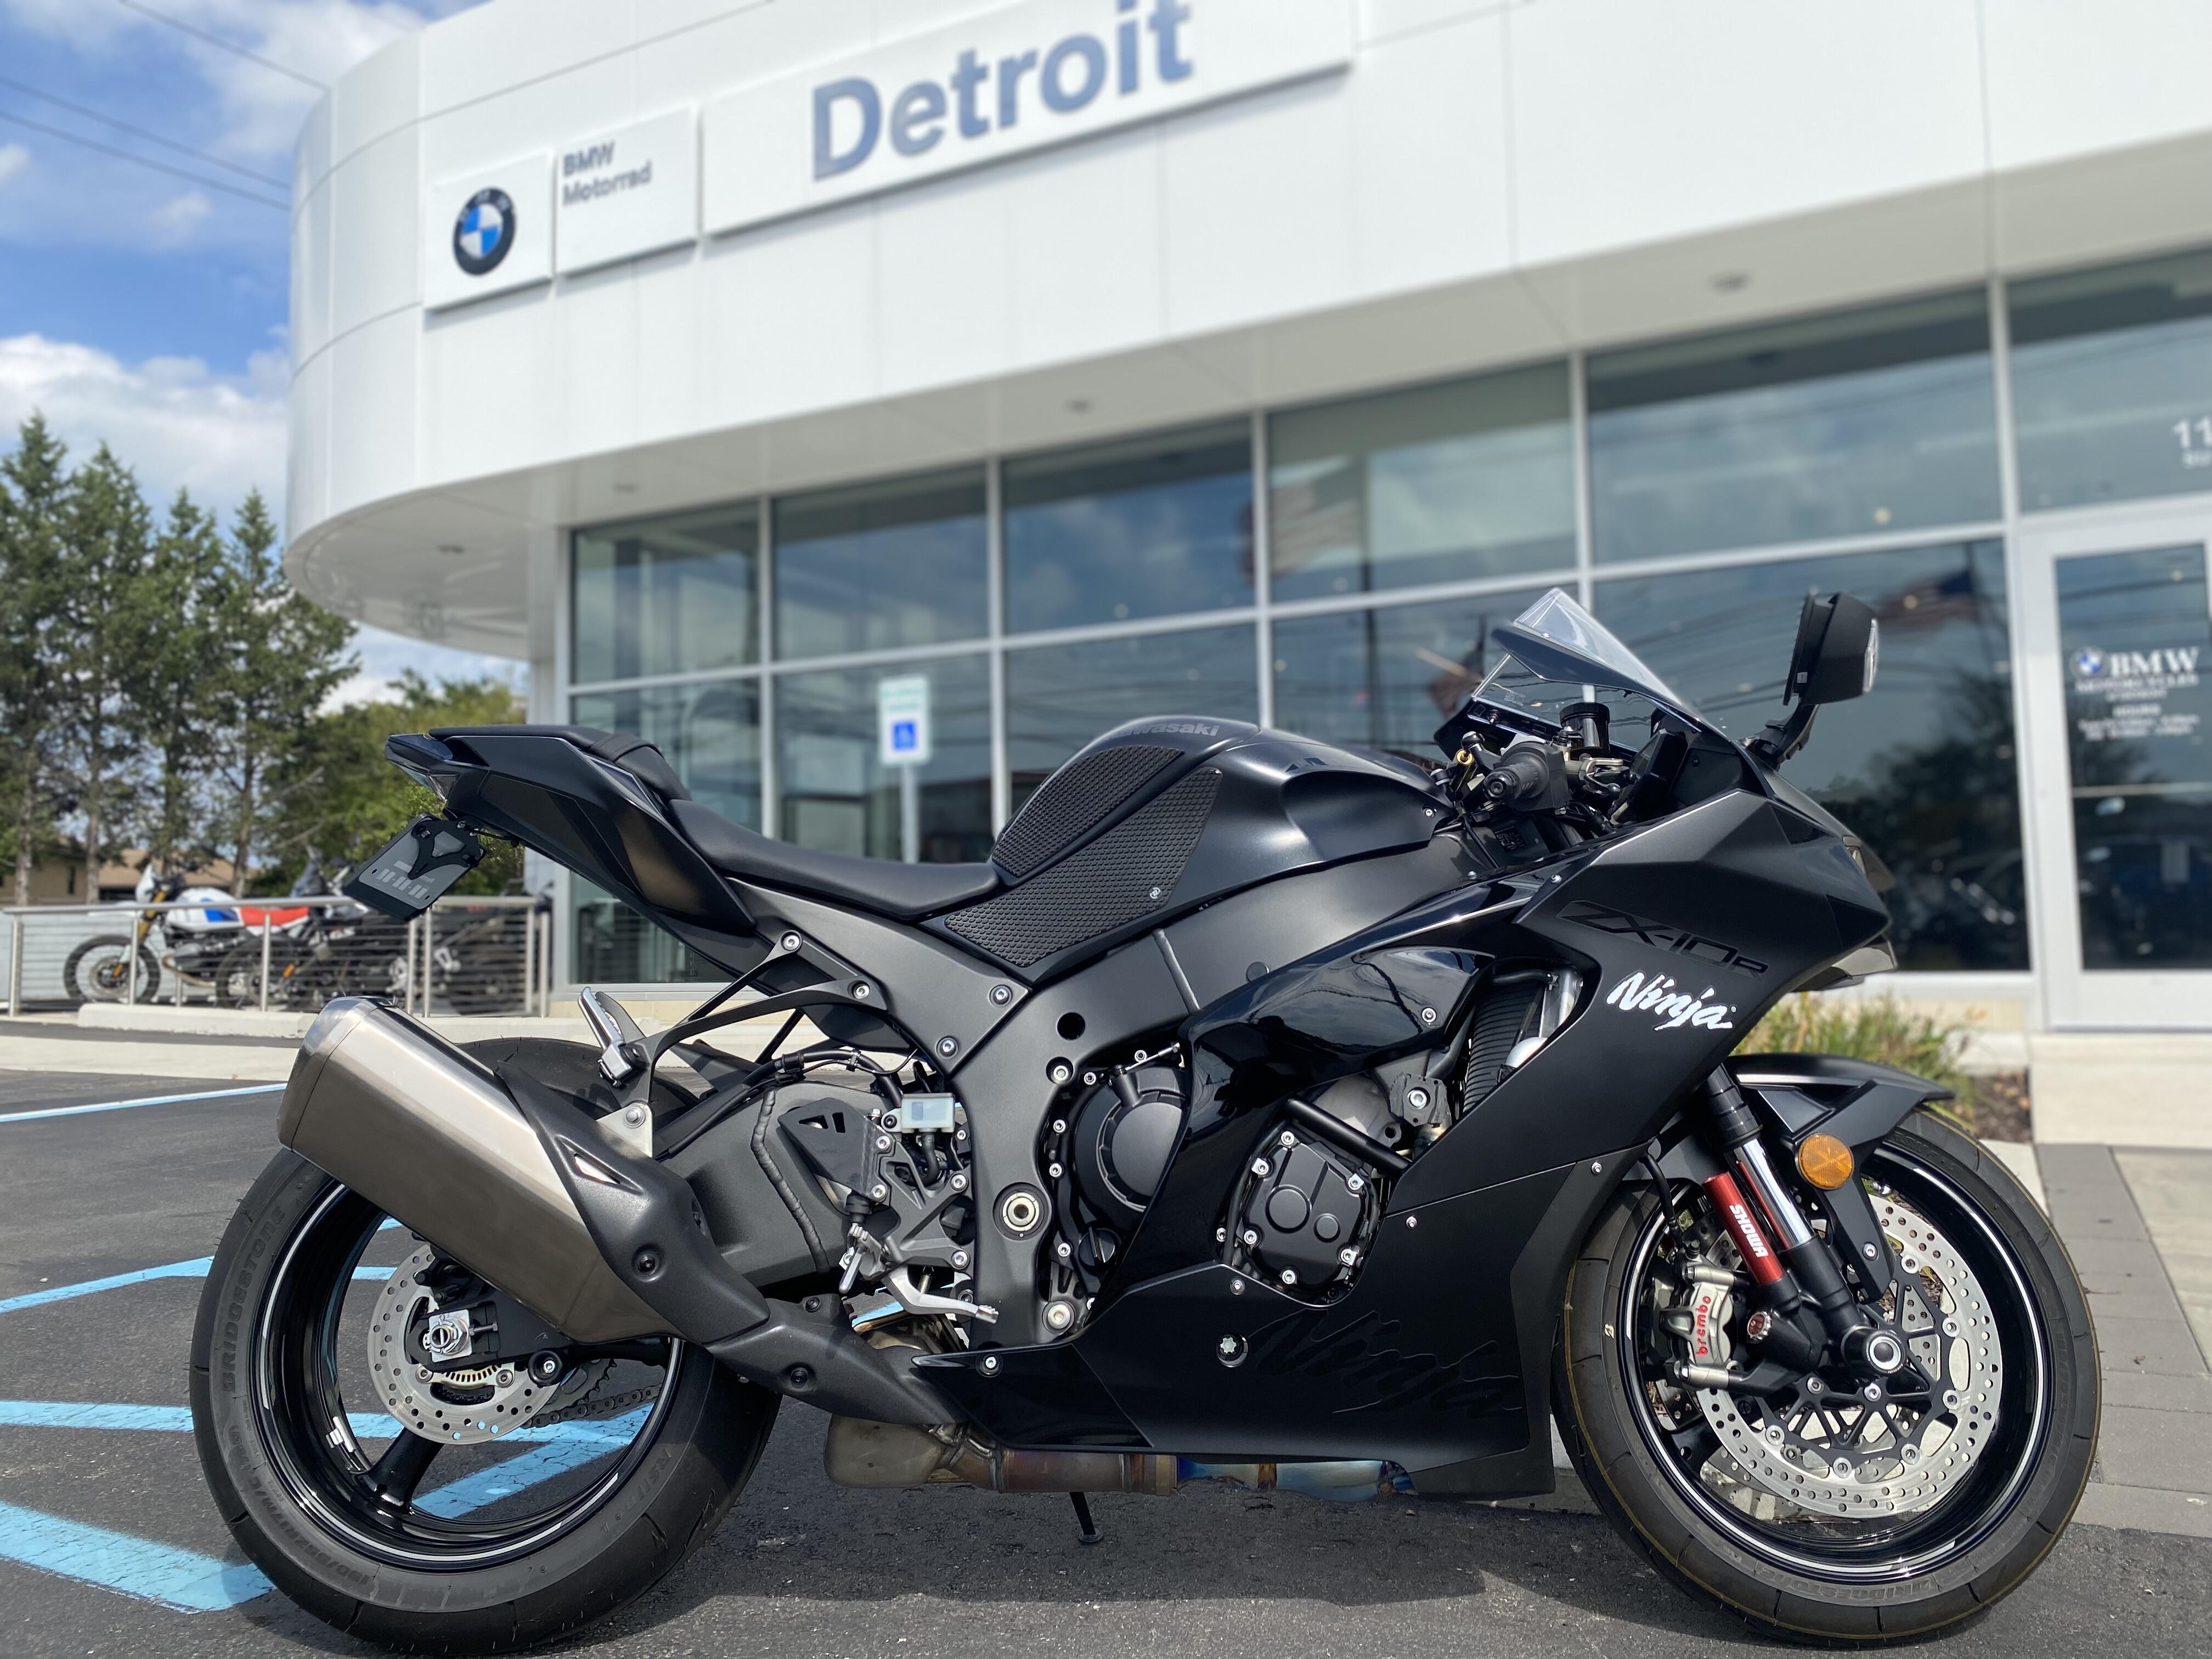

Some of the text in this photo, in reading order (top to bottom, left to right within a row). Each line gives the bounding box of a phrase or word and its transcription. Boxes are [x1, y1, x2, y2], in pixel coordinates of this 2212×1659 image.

[812, 0, 1193, 182] Detroit
[563, 138, 616, 178] BMW
[563, 158, 653, 206] Motorrad
[2111, 645, 2199, 676] BMW
[1556, 900, 1769, 983] ZX-10R
[1606, 971, 1734, 1031] Ninja
[1729, 1204, 1769, 1259] SHOWA
[222, 1205, 286, 1393] BRIDGESTONE
[1695, 1295, 1712, 1356] brembo
